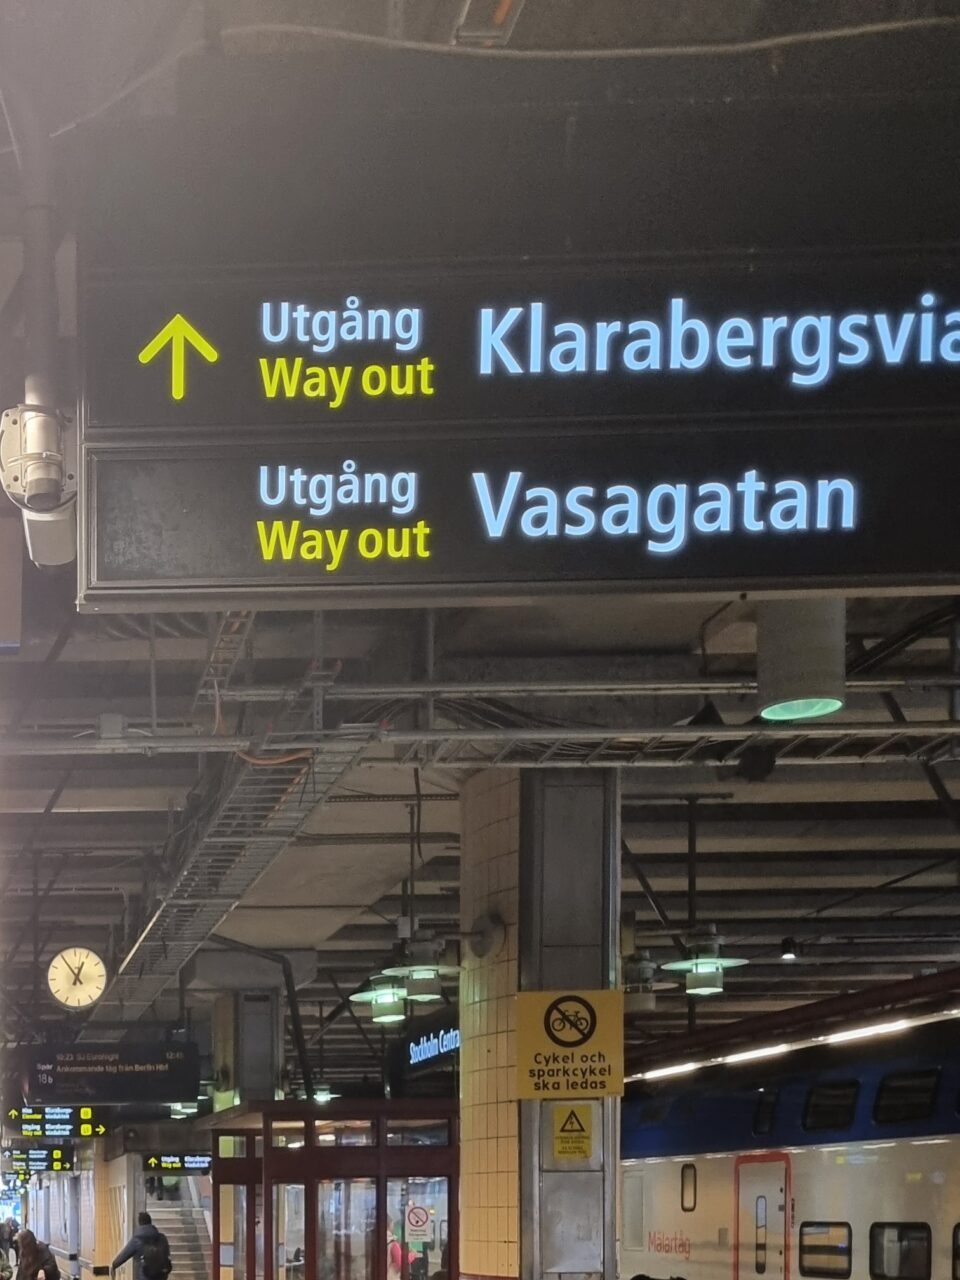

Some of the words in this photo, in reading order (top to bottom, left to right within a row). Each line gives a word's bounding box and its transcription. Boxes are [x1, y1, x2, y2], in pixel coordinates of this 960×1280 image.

[261, 294, 422, 355] Utgång
[478, 292, 960, 387] Klarabergsvia
[258, 357, 353, 409] Way
[361, 357, 435, 396] out
[258, 459, 418, 517] Utgång
[471, 468, 856, 554] Vasagatan
[256, 520, 349, 571] Way
[358, 520, 430, 559] out
[134, 1063, 155, 1072] Berlin
[409, 1032, 439, 1065] Stockholm
[534, 1052, 575, 1067] Cykel
[580, 1051, 606, 1064] och
[529, 1064, 611, 1080] sparkcykel
[534, 1079, 561, 1091] ska
[566, 1078, 607, 1090] ledas
[648, 1230, 691, 1261] Mälartåg
